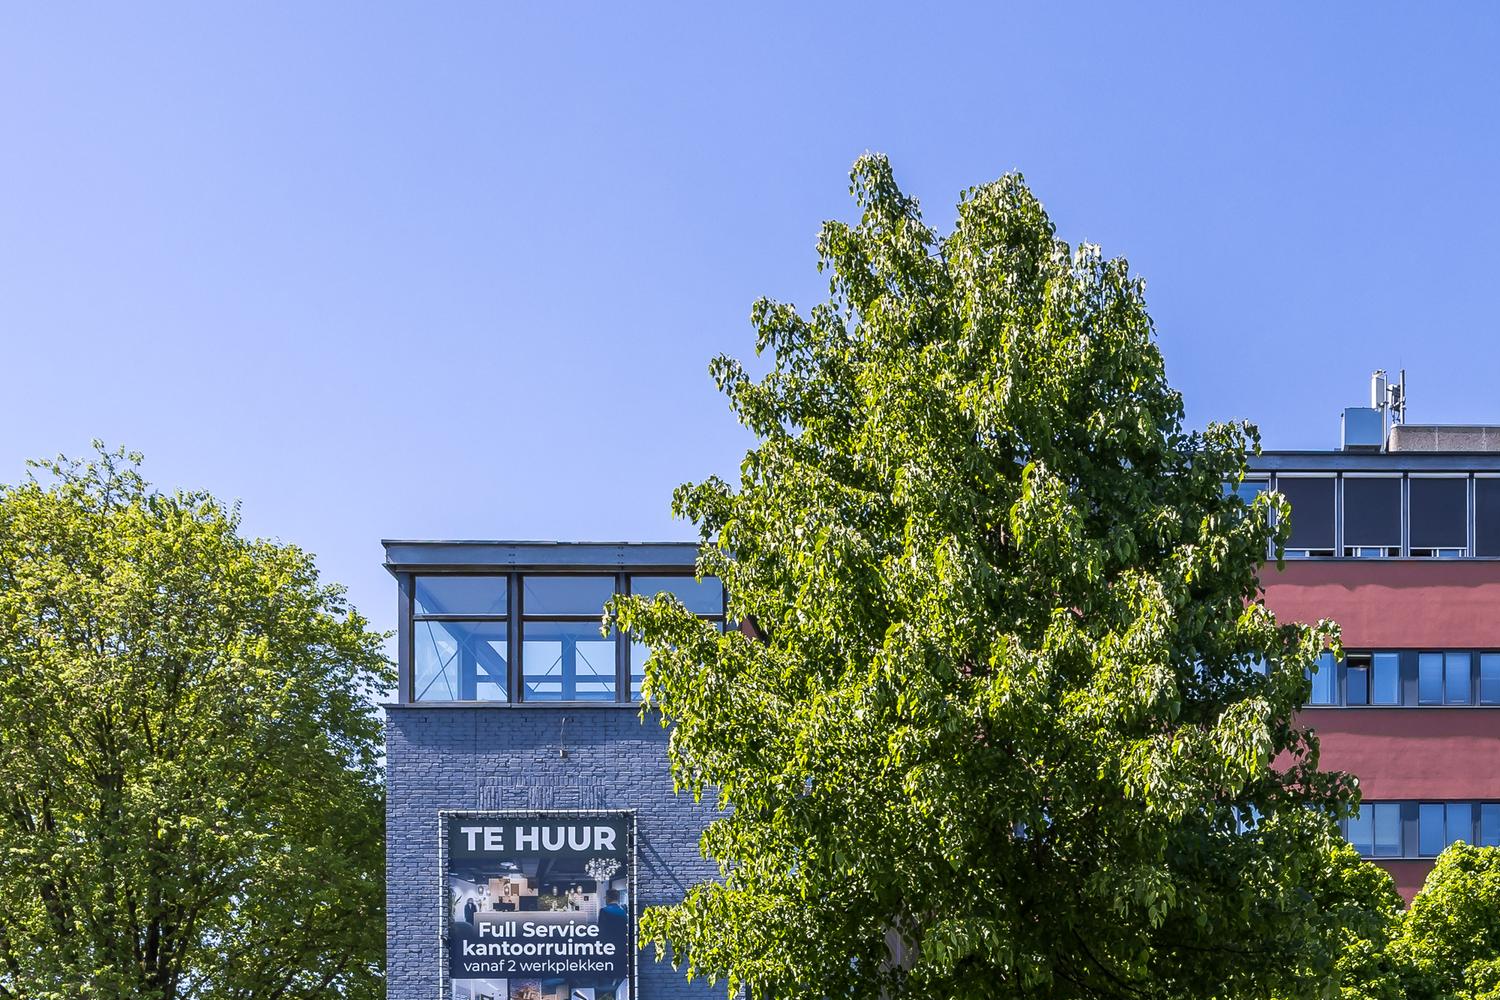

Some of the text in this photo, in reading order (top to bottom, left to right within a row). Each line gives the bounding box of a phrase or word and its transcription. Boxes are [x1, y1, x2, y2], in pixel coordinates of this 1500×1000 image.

[461, 826, 616, 851] TE HUUR
[479, 921, 600, 938] Full Service
[462, 939, 616, 956] kantoorruimte
[463, 960, 614, 974] vanaf 2 werkplekken
